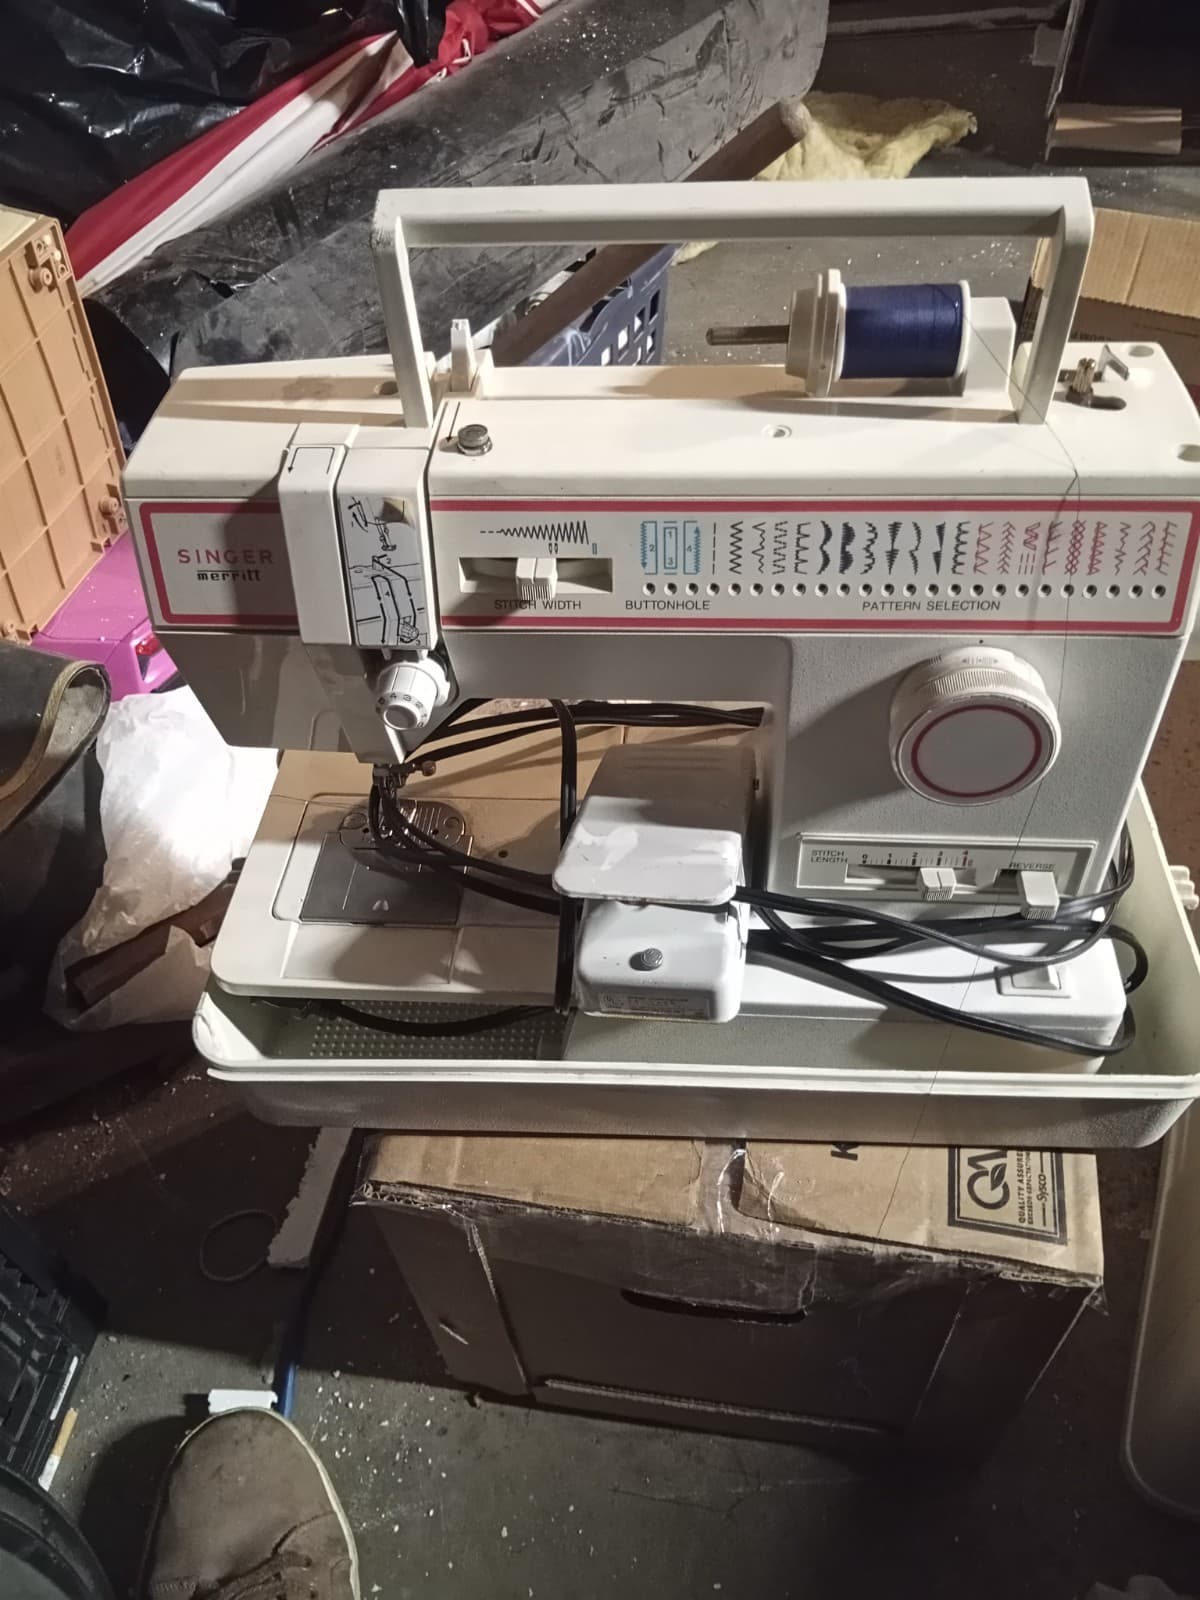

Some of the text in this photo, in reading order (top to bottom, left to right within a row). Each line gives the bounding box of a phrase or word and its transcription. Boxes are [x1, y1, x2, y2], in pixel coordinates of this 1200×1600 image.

[177, 549, 274, 564] SINGER
[197, 569, 262, 581] merritt
[494, 600, 582, 610] STITCH WIDTH
[625, 600, 710, 610] BUTTONHOLE
[862, 600, 1001, 611] PATTERN SELECTION
[1016, 1150, 1026, 1224] QUALITY ASSURE
[1036, 1174, 1049, 1202] Sysco
